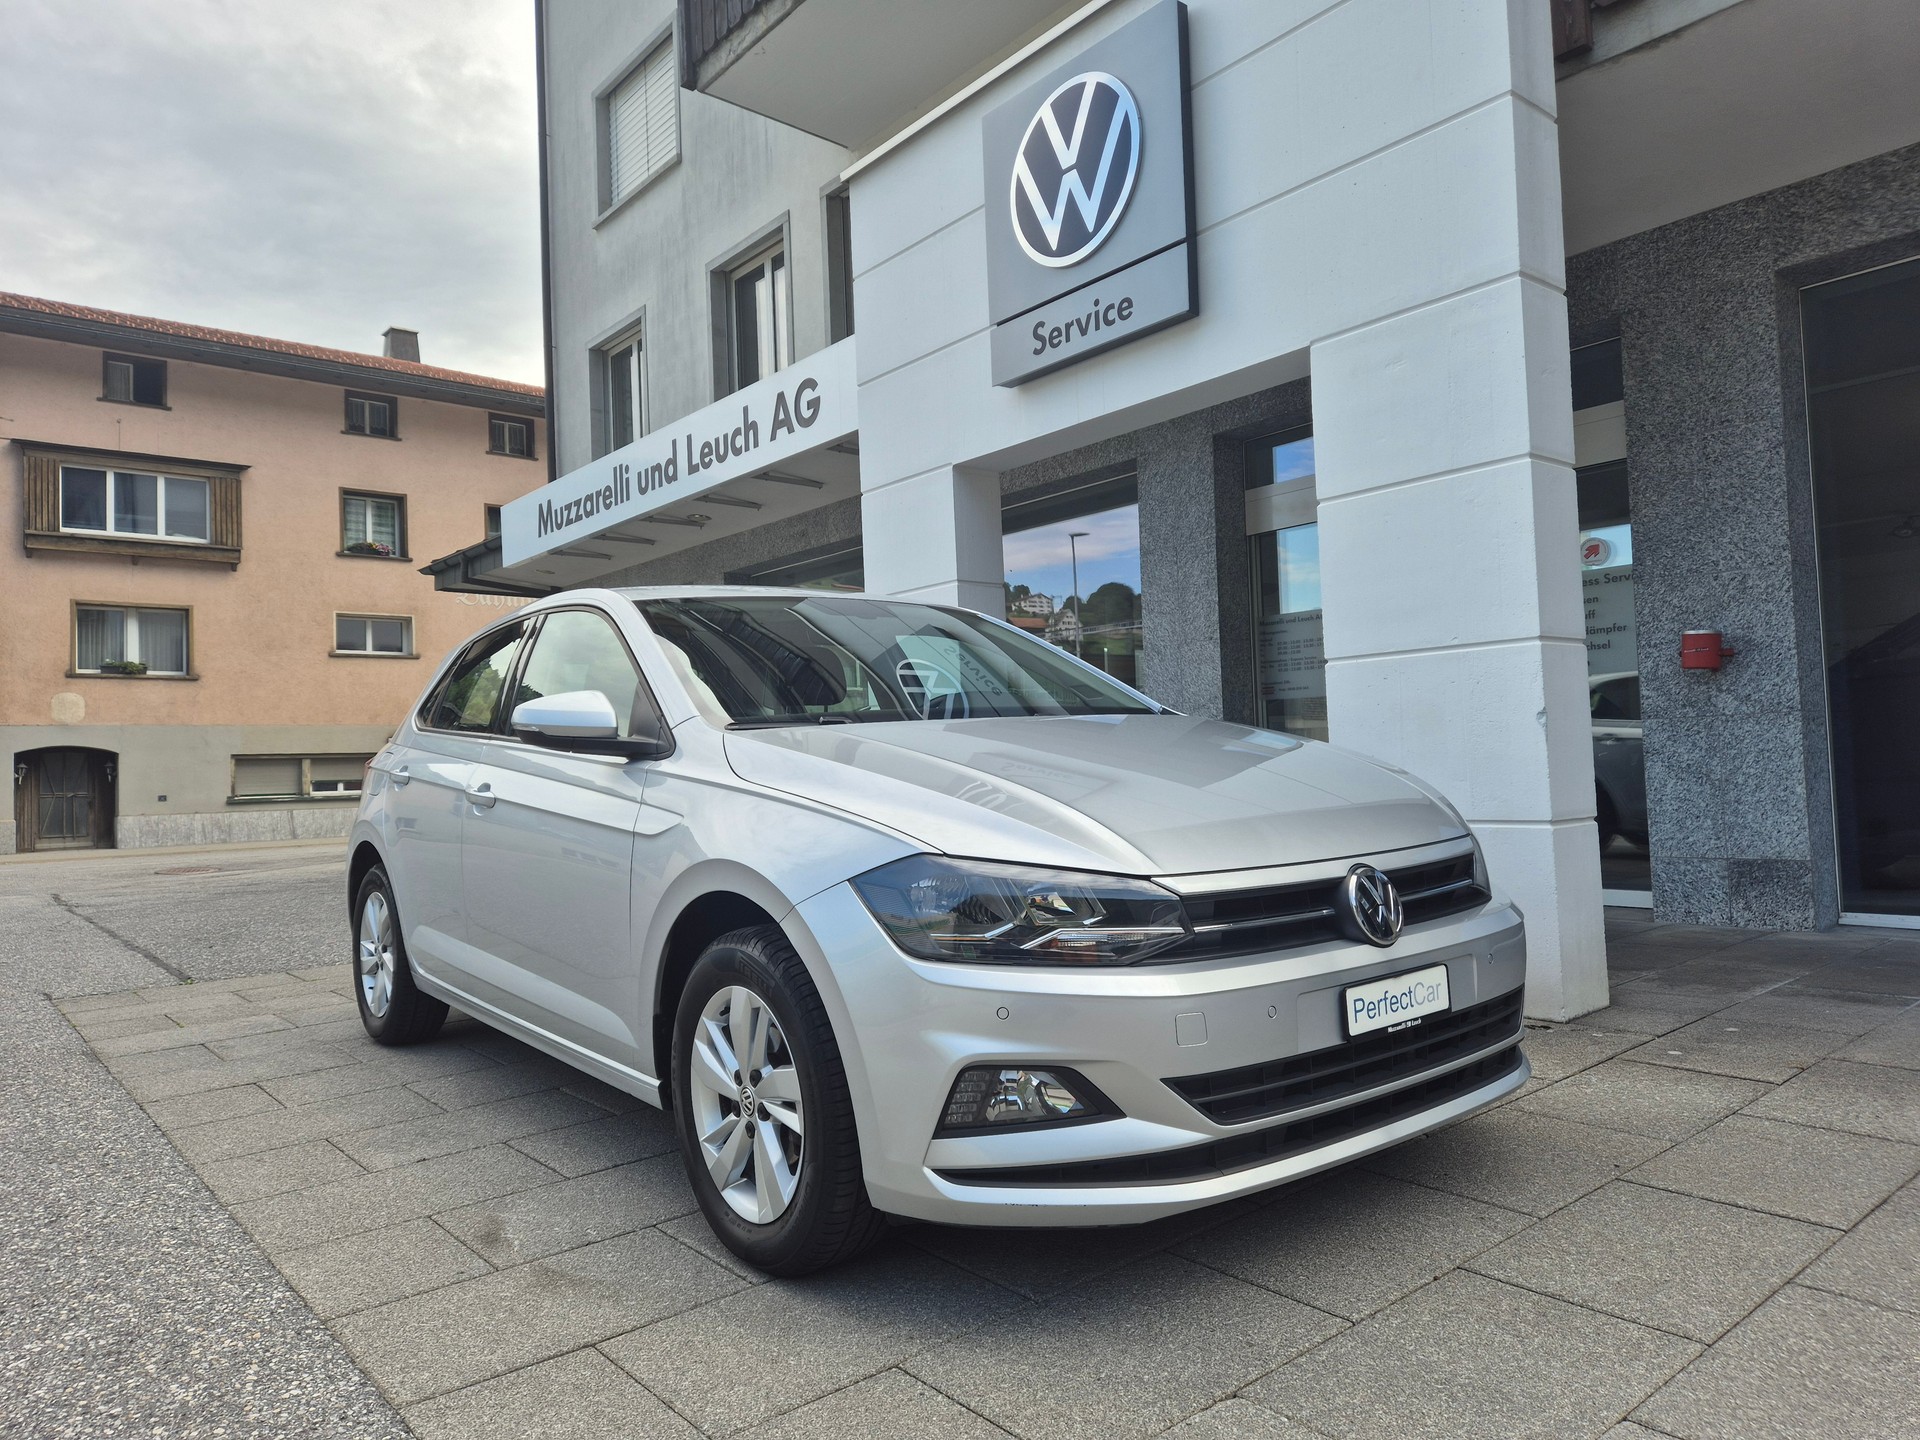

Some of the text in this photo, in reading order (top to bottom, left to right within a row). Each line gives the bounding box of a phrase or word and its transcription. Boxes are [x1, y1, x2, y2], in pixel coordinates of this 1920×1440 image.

[1010, 72, 1140, 266] VW
[1032, 295, 1133, 355] Service
[537, 377, 821, 538] Muzzarelli und Leuch AG
[1353, 982, 1442, 1023] PerfectCar
